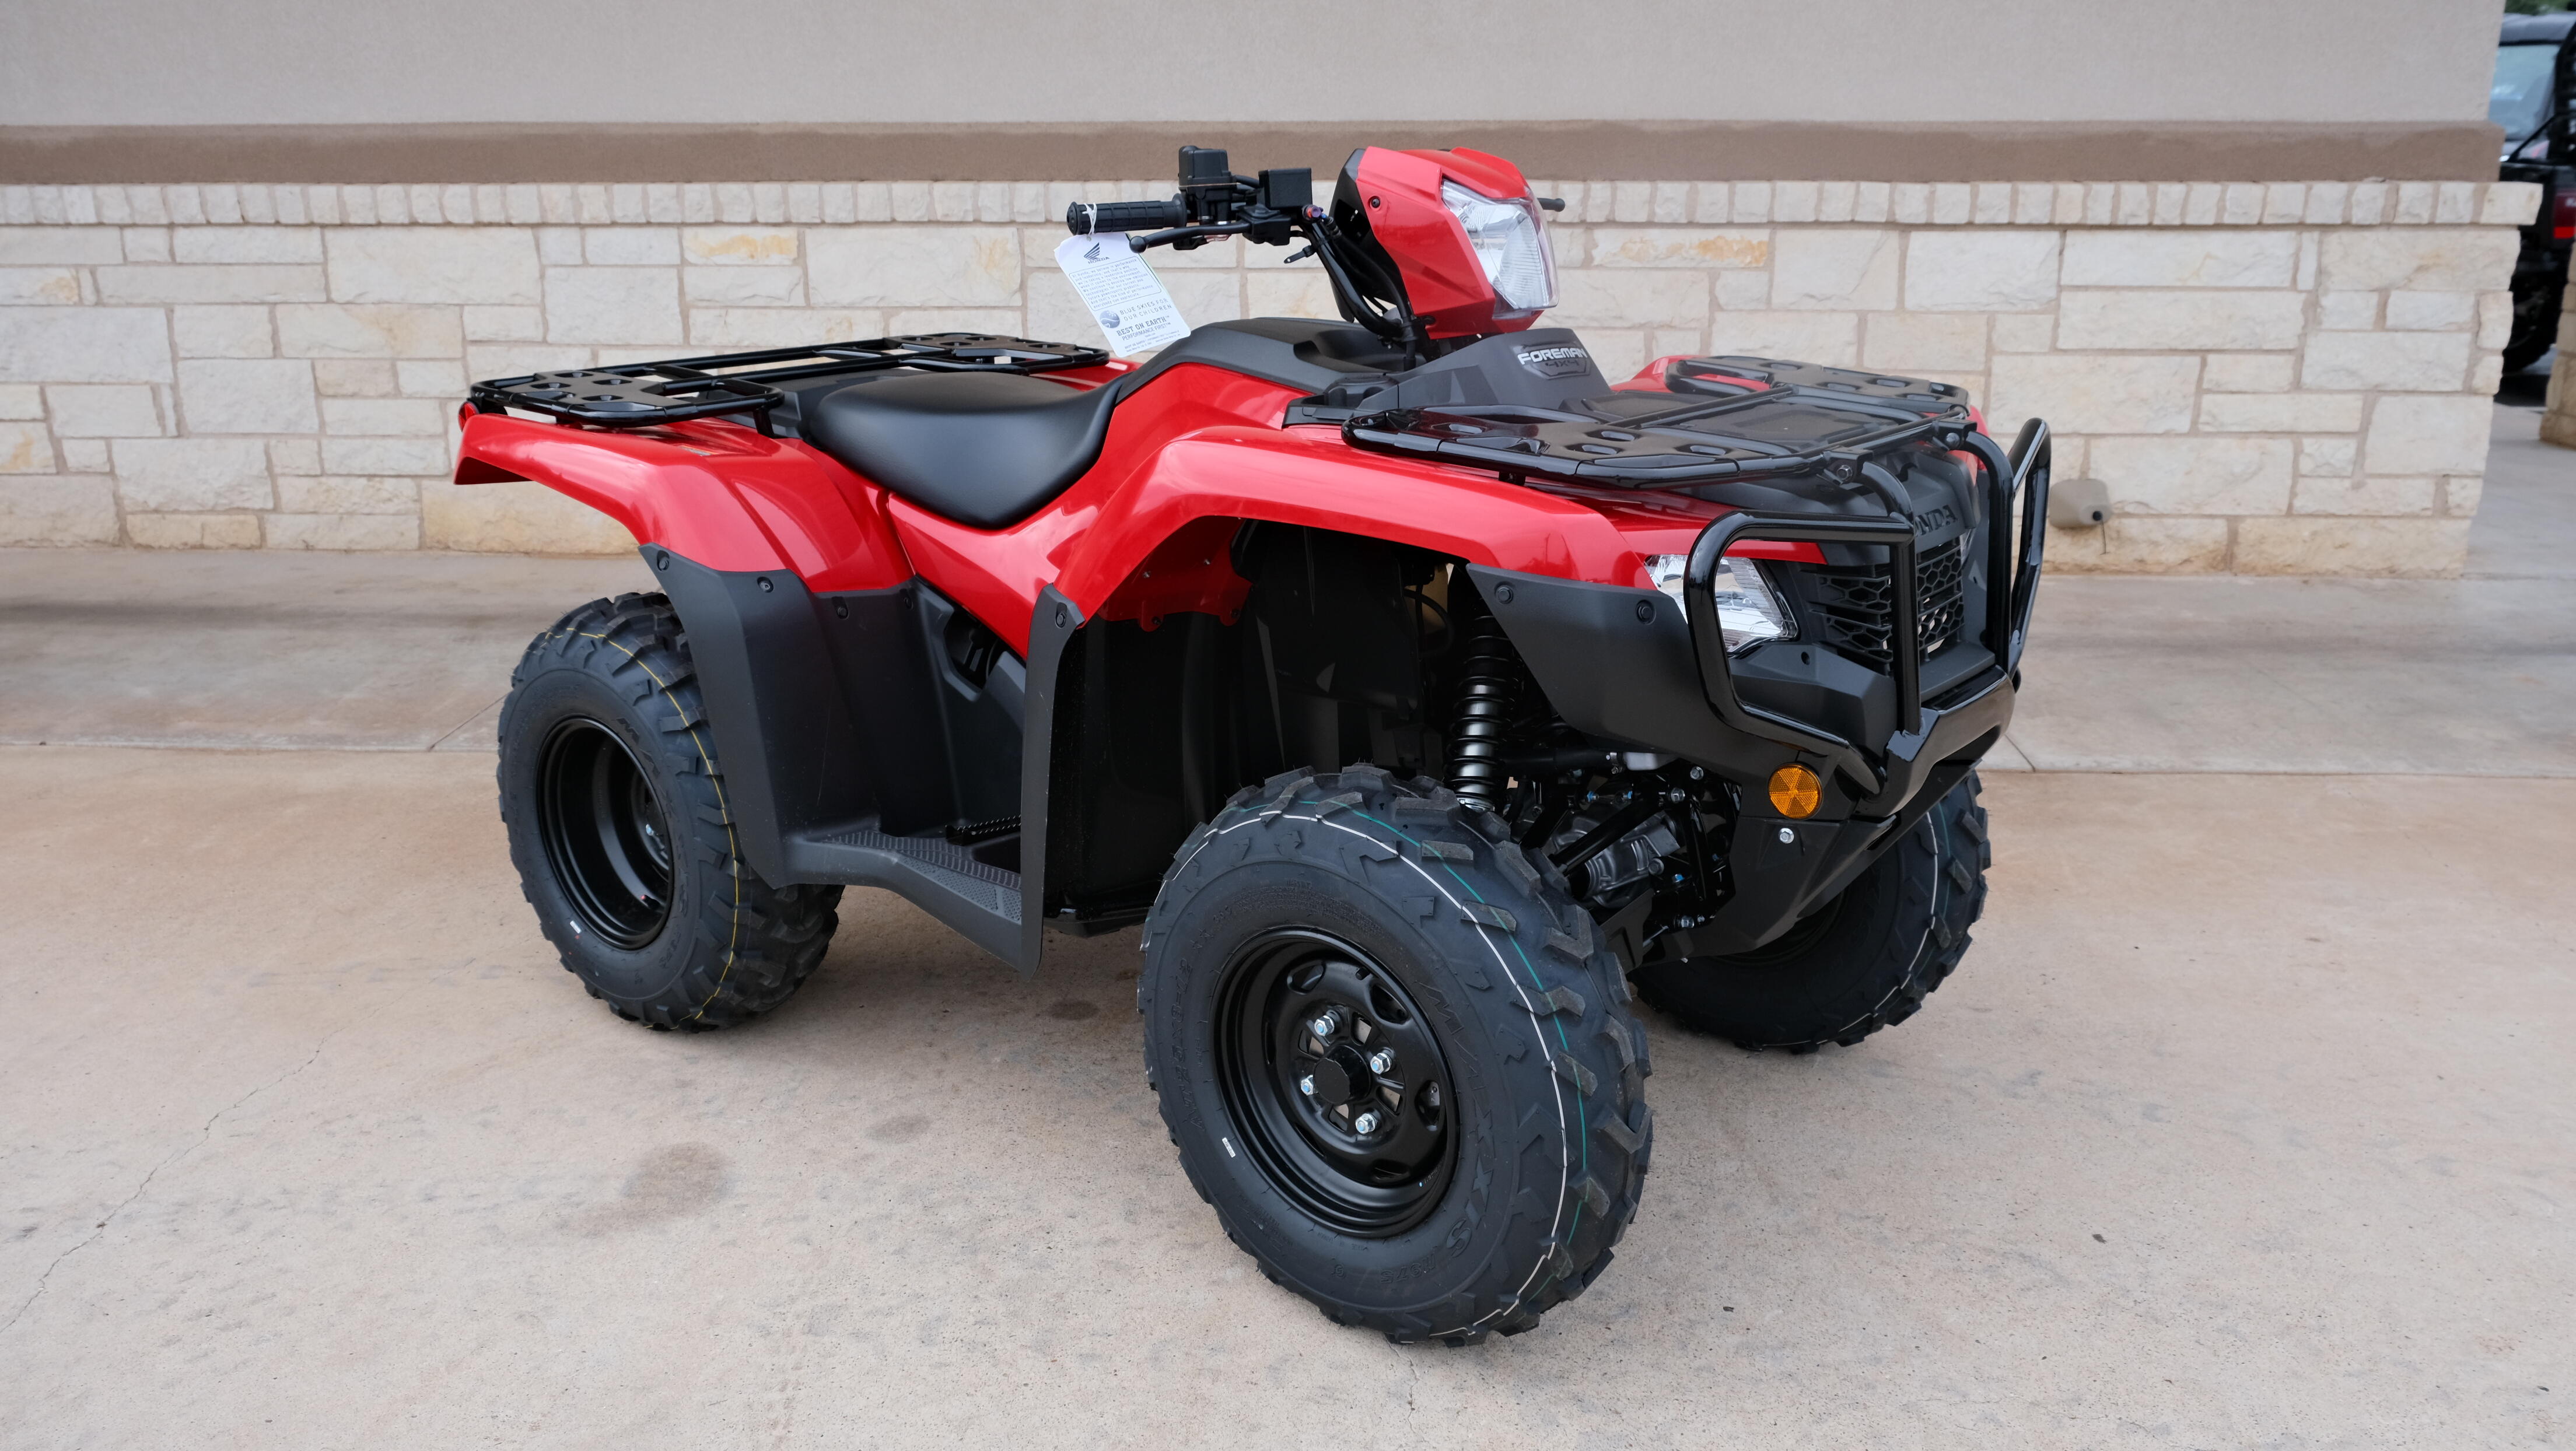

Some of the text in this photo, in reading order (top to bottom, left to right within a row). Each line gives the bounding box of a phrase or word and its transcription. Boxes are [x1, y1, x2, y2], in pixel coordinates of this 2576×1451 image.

[1120, 307, 1136, 315] BLUE
[1136, 302, 1155, 310] SKIES
[1139, 304, 1172, 317] CHILDREN
[1116, 327, 1133, 336] BEST
[1122, 327, 1155, 341] PERFORMANCE
[1517, 348, 1588, 365] FOREMAN
[1415, 980, 1496, 1259] MAXXIS
